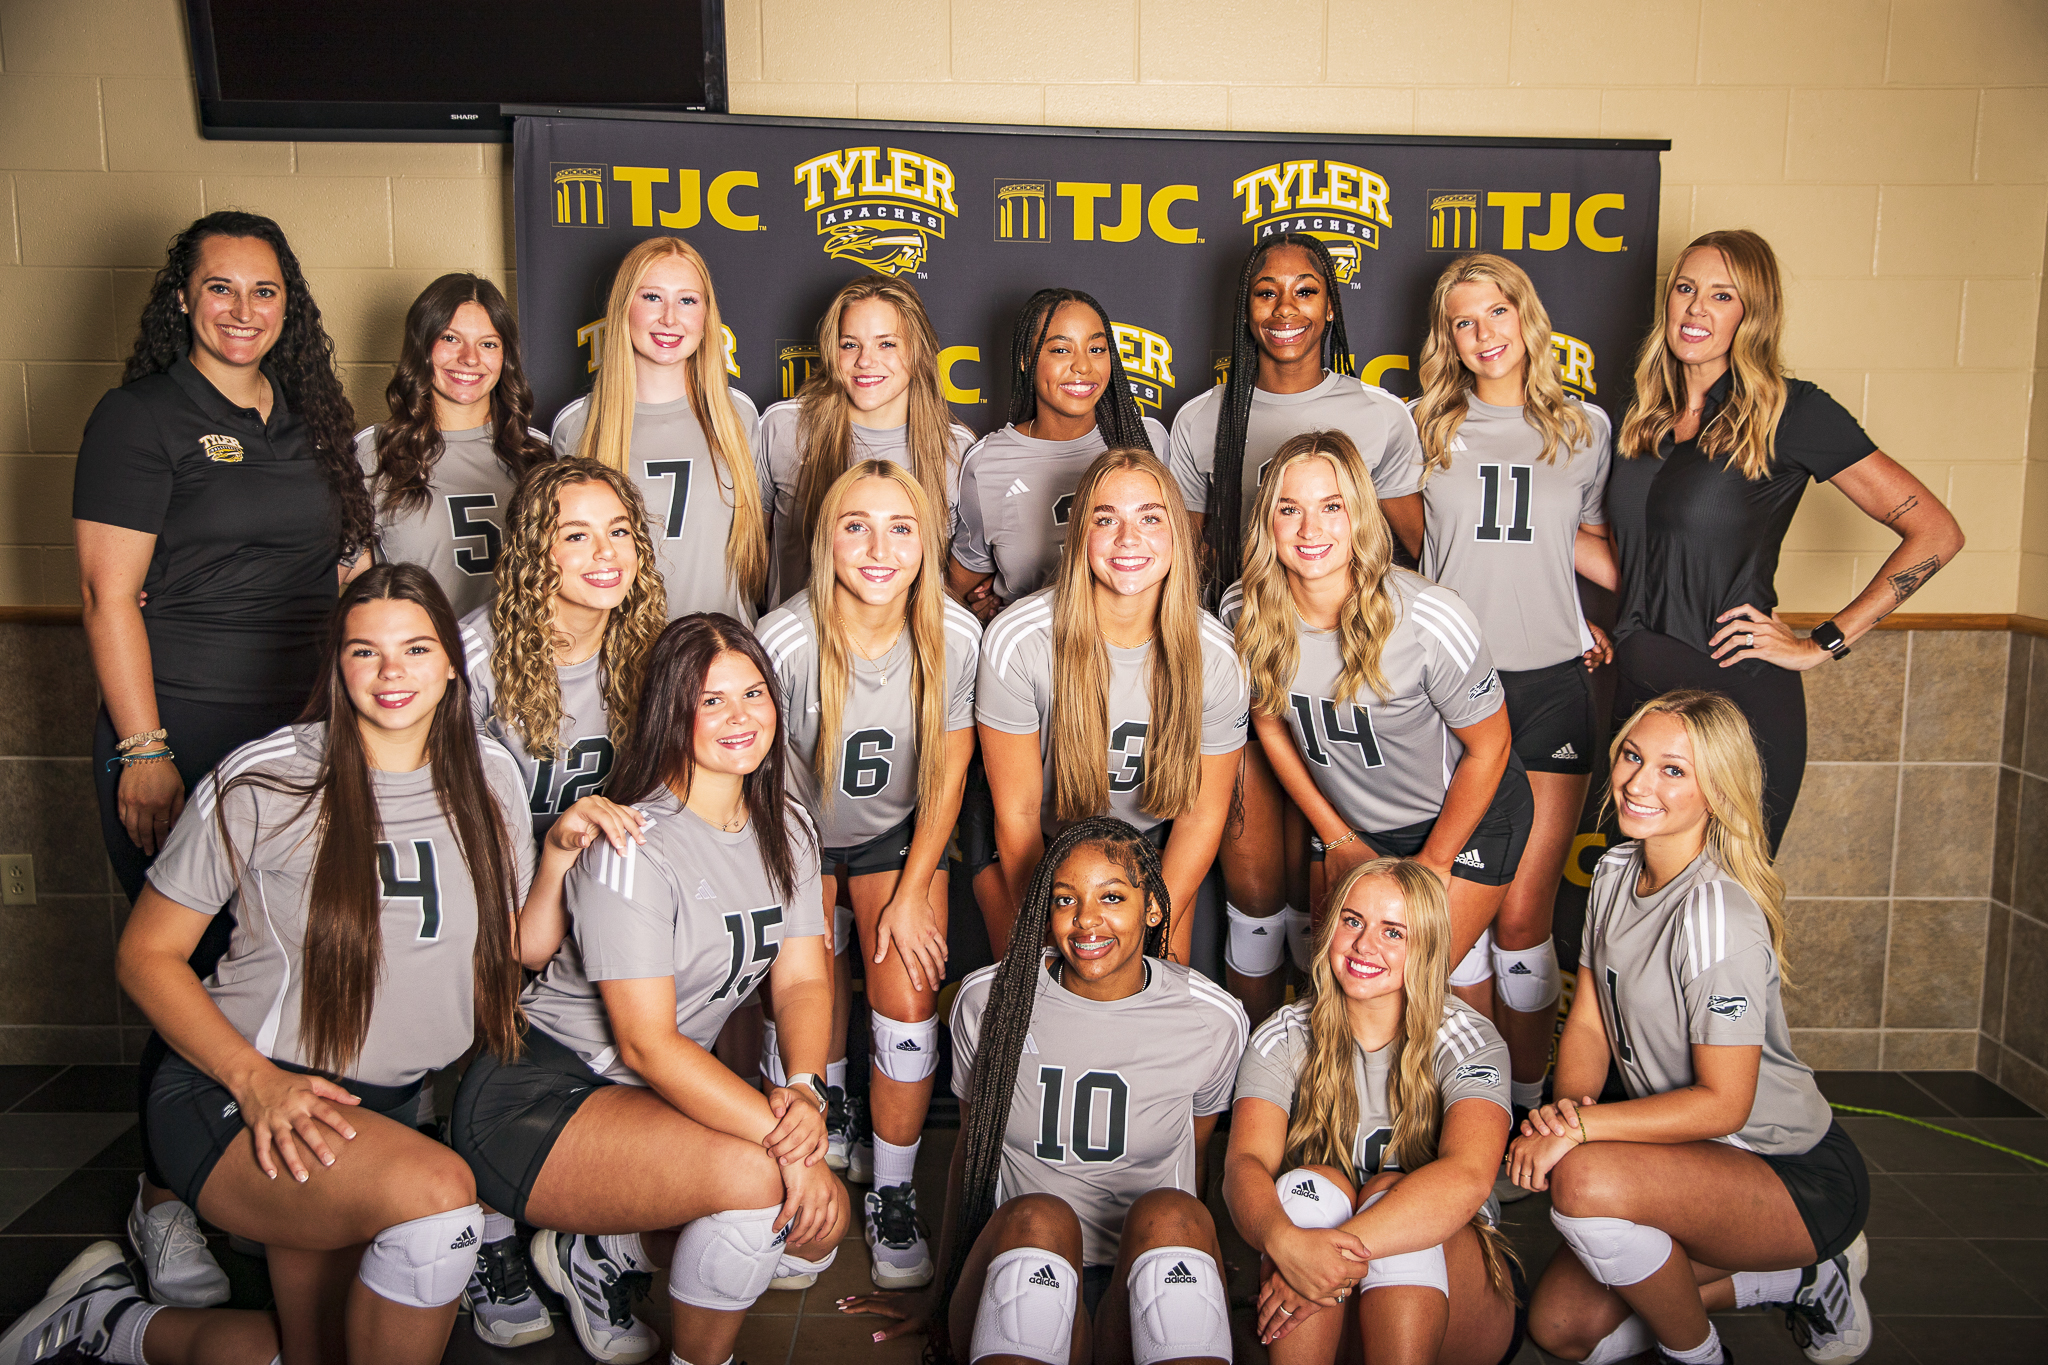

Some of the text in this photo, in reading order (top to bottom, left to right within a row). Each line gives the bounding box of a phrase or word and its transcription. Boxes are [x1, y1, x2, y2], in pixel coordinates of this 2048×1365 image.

[613, 166, 760, 232] TJC
[794, 146, 958, 218] TYLER
[1056, 181, 1199, 244] TJC
[1233, 160, 1392, 228] TYLER
[825, 206, 937, 228] APACHES
[1262, 219, 1371, 239] APACHES
[1487, 192, 1625, 252] TJC
[916, 272, 928, 280] TM
[1350, 282, 1361, 290] TM
[198, 433, 244, 450] TYLER
[643, 458, 693, 540] 7
[1474, 463, 1535, 544] 11
[445, 493, 502, 576] 5
[839, 726, 896, 800] 6
[1107, 719, 1149, 794] 3
[1290, 693, 1386, 770] 14
[1551, 752, 1579, 760] adidas
[529, 734, 616, 816] 12
[376, 837, 442, 942] 4
[704, 902, 785, 1006] 15
[1606, 964, 1633, 1066] 1
[1035, 1063, 1131, 1165] 10
[1291, 1187, 1320, 1202] adidas
[450, 1236, 478, 1250] adidas
[1028, 1276, 1060, 1289] adidas
[1164, 1274, 1198, 1284] adidas
